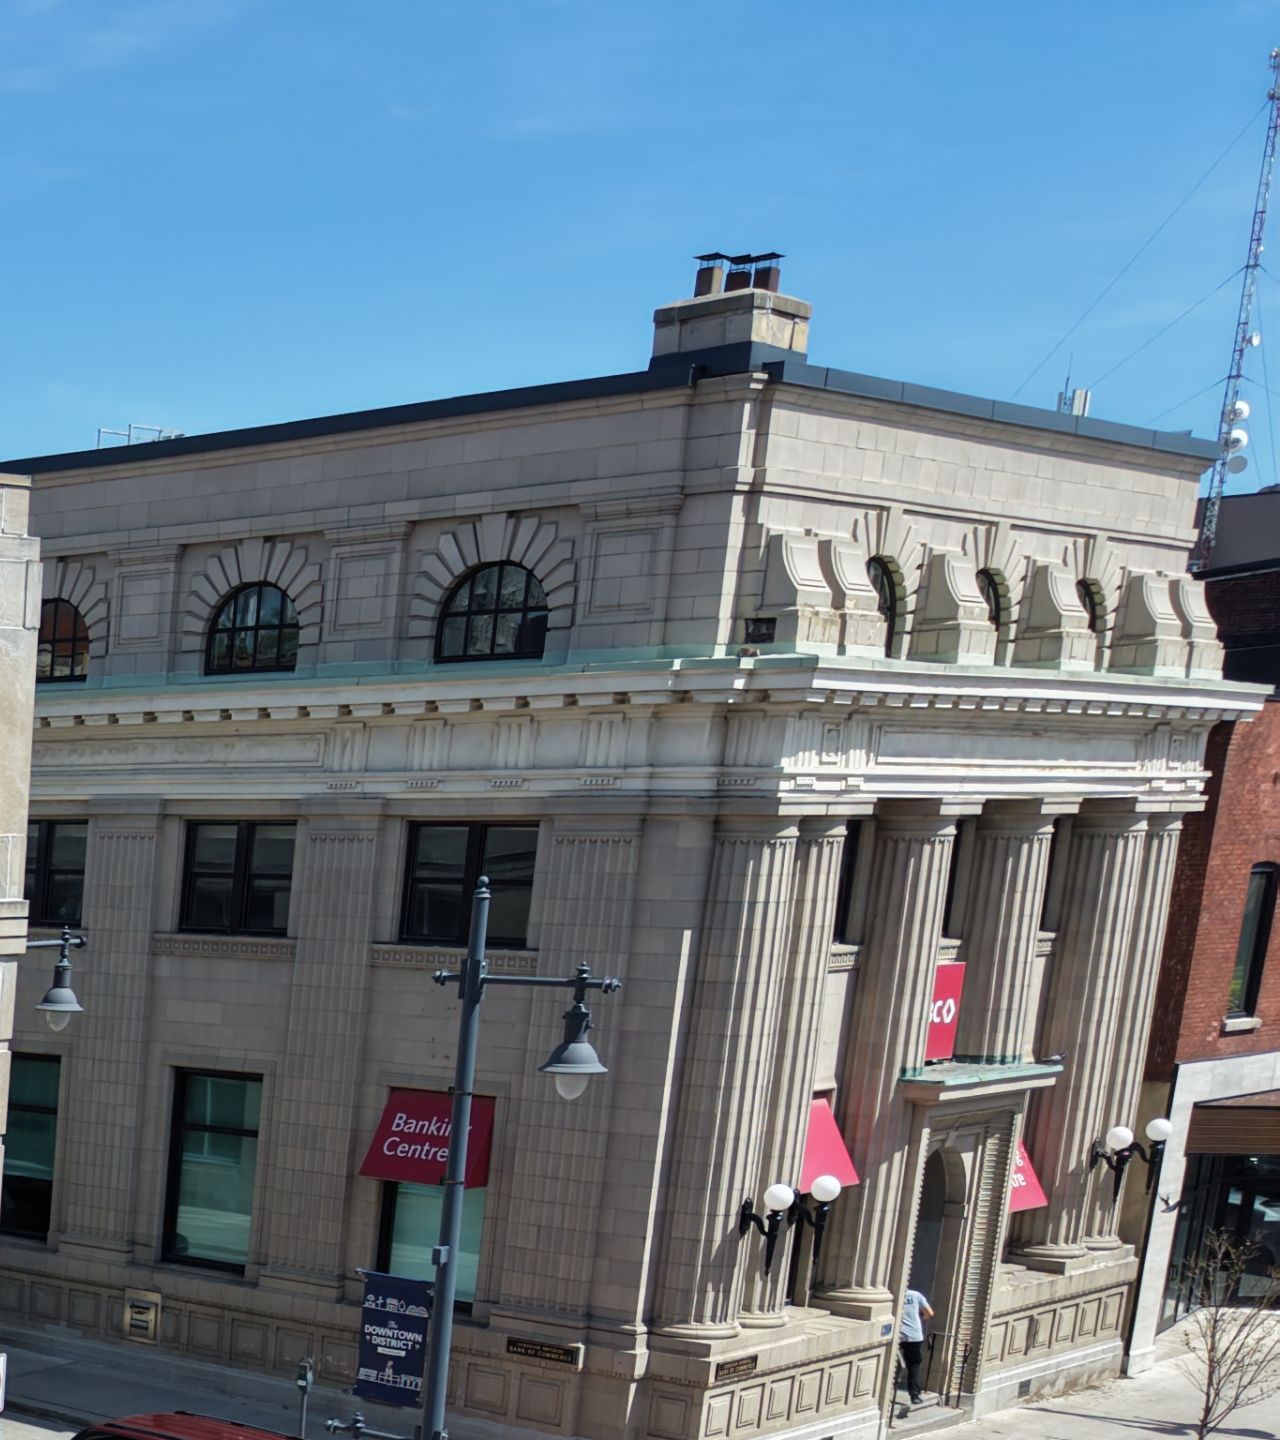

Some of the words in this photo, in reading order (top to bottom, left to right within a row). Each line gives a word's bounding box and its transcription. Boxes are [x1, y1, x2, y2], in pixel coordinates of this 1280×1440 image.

[391, 1112, 473, 1137] Banki
[383, 1136, 449, 1162] Centre
[364, 1324, 423, 1343] DOWNTOWN
[371, 1335, 413, 1350] DISTRICT
